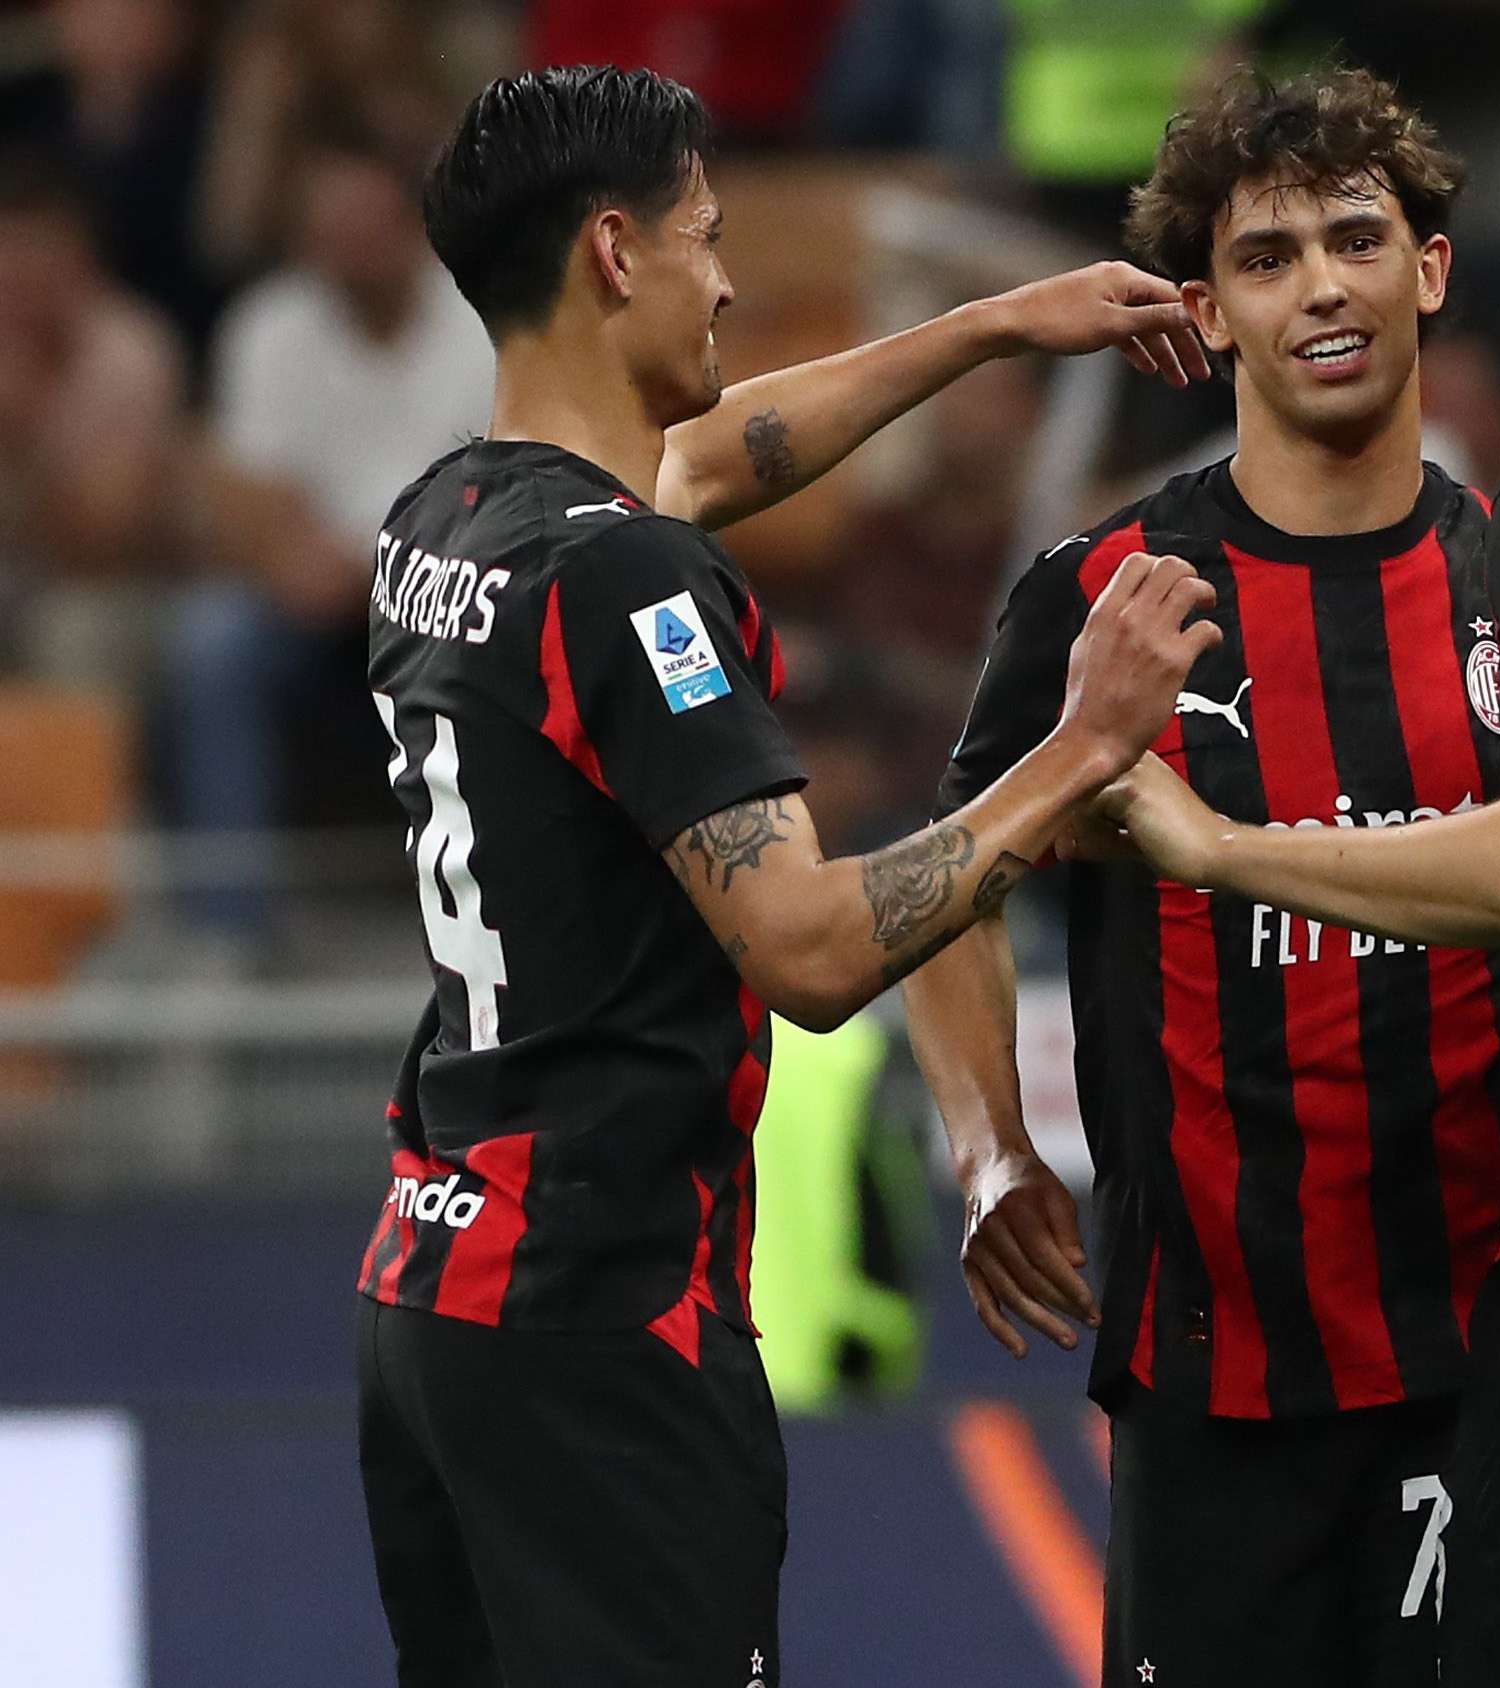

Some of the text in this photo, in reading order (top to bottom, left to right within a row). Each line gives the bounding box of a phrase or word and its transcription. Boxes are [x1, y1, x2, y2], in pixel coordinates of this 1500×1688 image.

[663, 651, 708, 675] SERIE A
[1251, 903, 1323, 968] FLY
